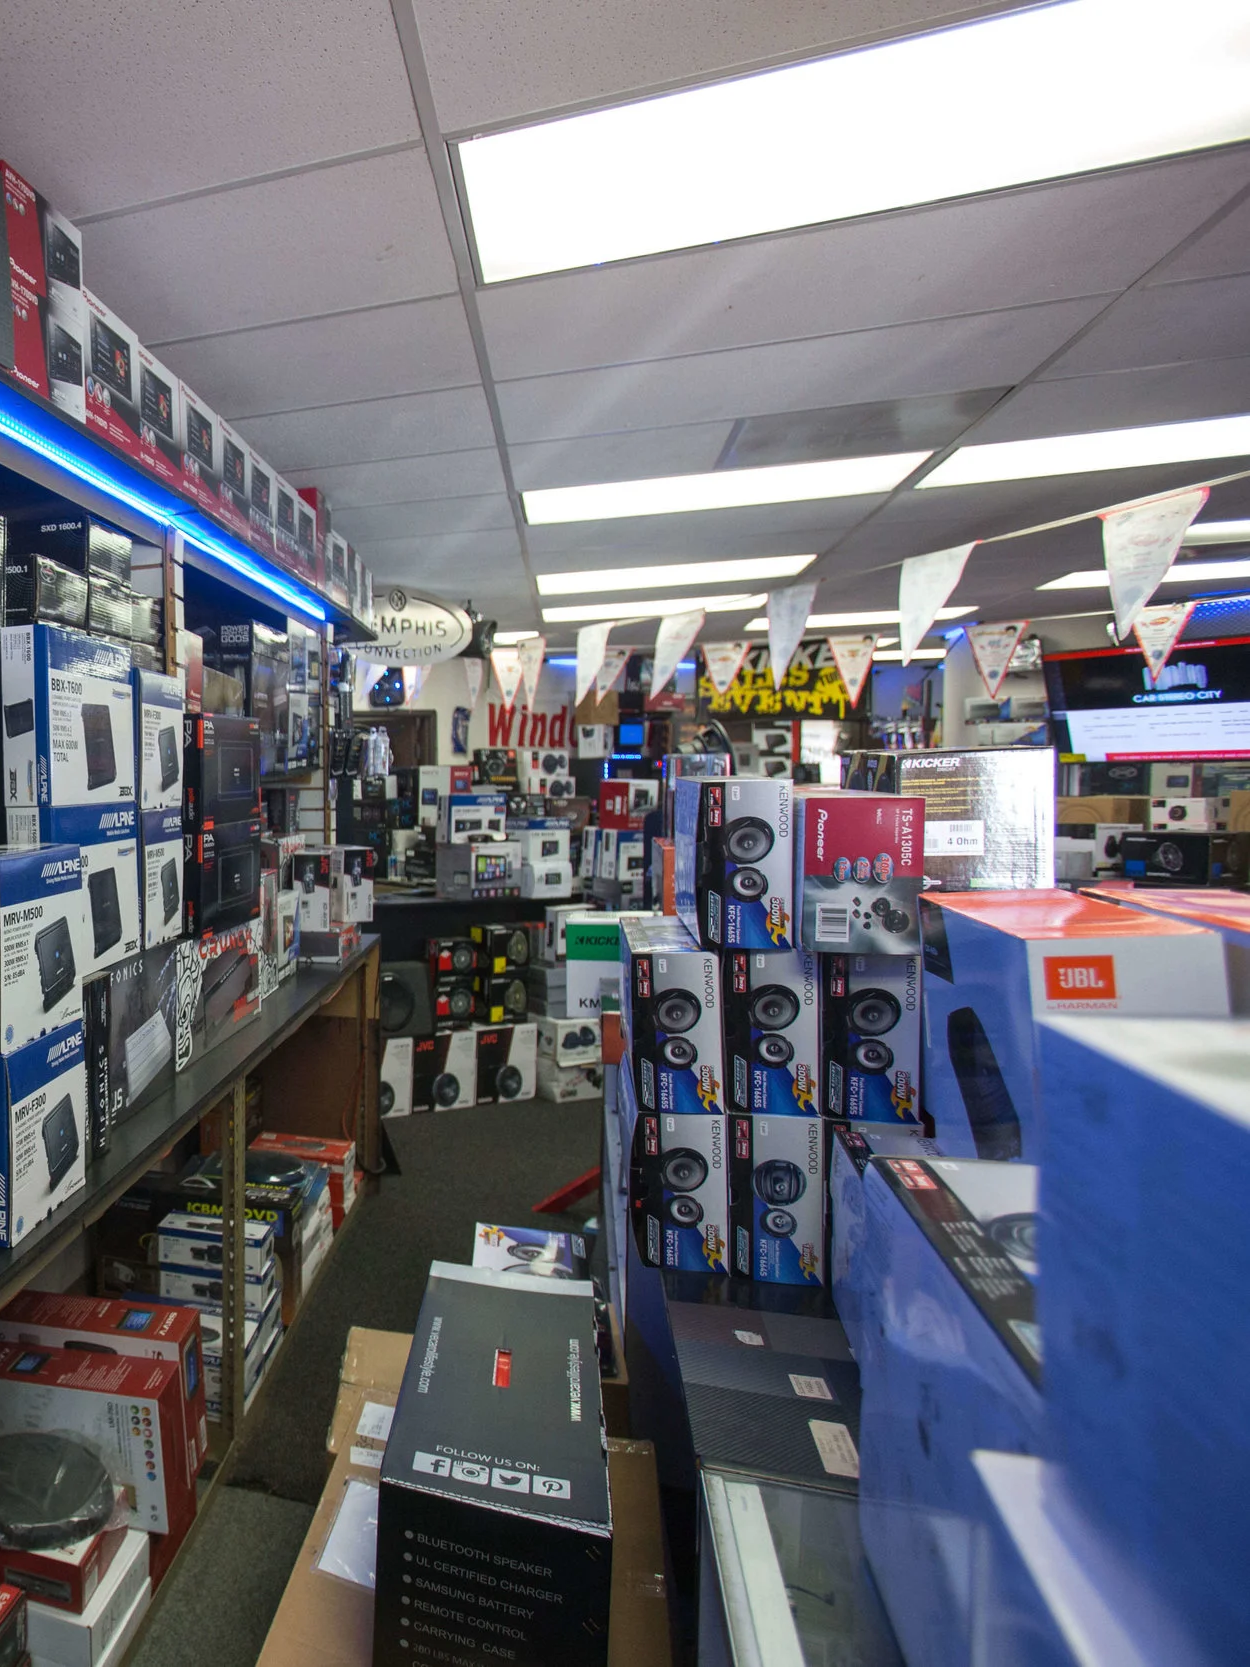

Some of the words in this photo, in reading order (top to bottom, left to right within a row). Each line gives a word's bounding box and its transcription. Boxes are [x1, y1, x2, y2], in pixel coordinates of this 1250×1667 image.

[9, 256, 38, 286] Pioneer
[11, 364, 40, 390] Pioneer
[40, 524, 57, 533] SXD
[57, 520, 83, 532] 1600.4
[374, 614, 447, 637] MPHIS
[51, 677, 83, 696] BBX-T600
[1132, 693, 1156, 703] CAR
[1196, 689, 1223, 700] CITY
[52, 739, 65, 750] MAX
[184, 719, 193, 749] PA
[52, 751, 69, 763] TOTAL
[911, 757, 961, 769] KICKER
[778, 784, 789, 838] KENWOOD
[184, 834, 193, 863] PA
[816, 807, 829, 862] Pioneer
[900, 807, 913, 867] TS-A1305C
[946, 837, 953, 846] 4
[956, 836, 978, 846] Ohm
[2, 905, 44, 928] MRV-M500
[726, 904, 736, 944] KFC-1665S
[769, 896, 780, 927] 300W
[703, 958, 715, 1009] KENWOOD
[803, 950, 814, 1006] KENWOOD
[905, 957, 917, 1012] KENWOOD
[1057, 966, 1105, 989] JBL
[1056, 1001, 1118, 1010] HARMAN
[659, 1072, 669, 1110] KFC-1665S
[700, 1064, 711, 1095] 300W
[753, 1069, 762, 1109] KFC-1665S
[796, 1063, 807, 1093] 300W
[895, 1070, 907, 1101] 300W
[14, 1092, 47, 1124] MRV-F300
[711, 1118, 722, 1170] KENWOOD
[808, 1122, 818, 1175] KENWOOD
[665, 1229, 675, 1267] KFC-1665S
[705, 1223, 716, 1253] 300W
[435, 1444, 492, 1463] FOLLOW
[494, 1457, 512, 1468] US
[515, 1461, 541, 1473] ON:
[417, 1532, 490, 1564] BLUETOOTH
[492, 1555, 553, 1579] SPEAKER
[415, 1555, 431, 1569] UL
[433, 1560, 498, 1588] CERTIFIED
[499, 1579, 564, 1605] CHARGER
[414, 1577, 476, 1604] SAMSUNG
[478, 1596, 535, 1621] BATTERY
[413, 1599, 465, 1625] REMOTE
[466, 1615, 527, 1642] CONTROL
[413, 1620, 477, 1649] CARRYING
[481, 1642, 517, 1661] CASE
[432, 1648, 451, 1663] LBS
